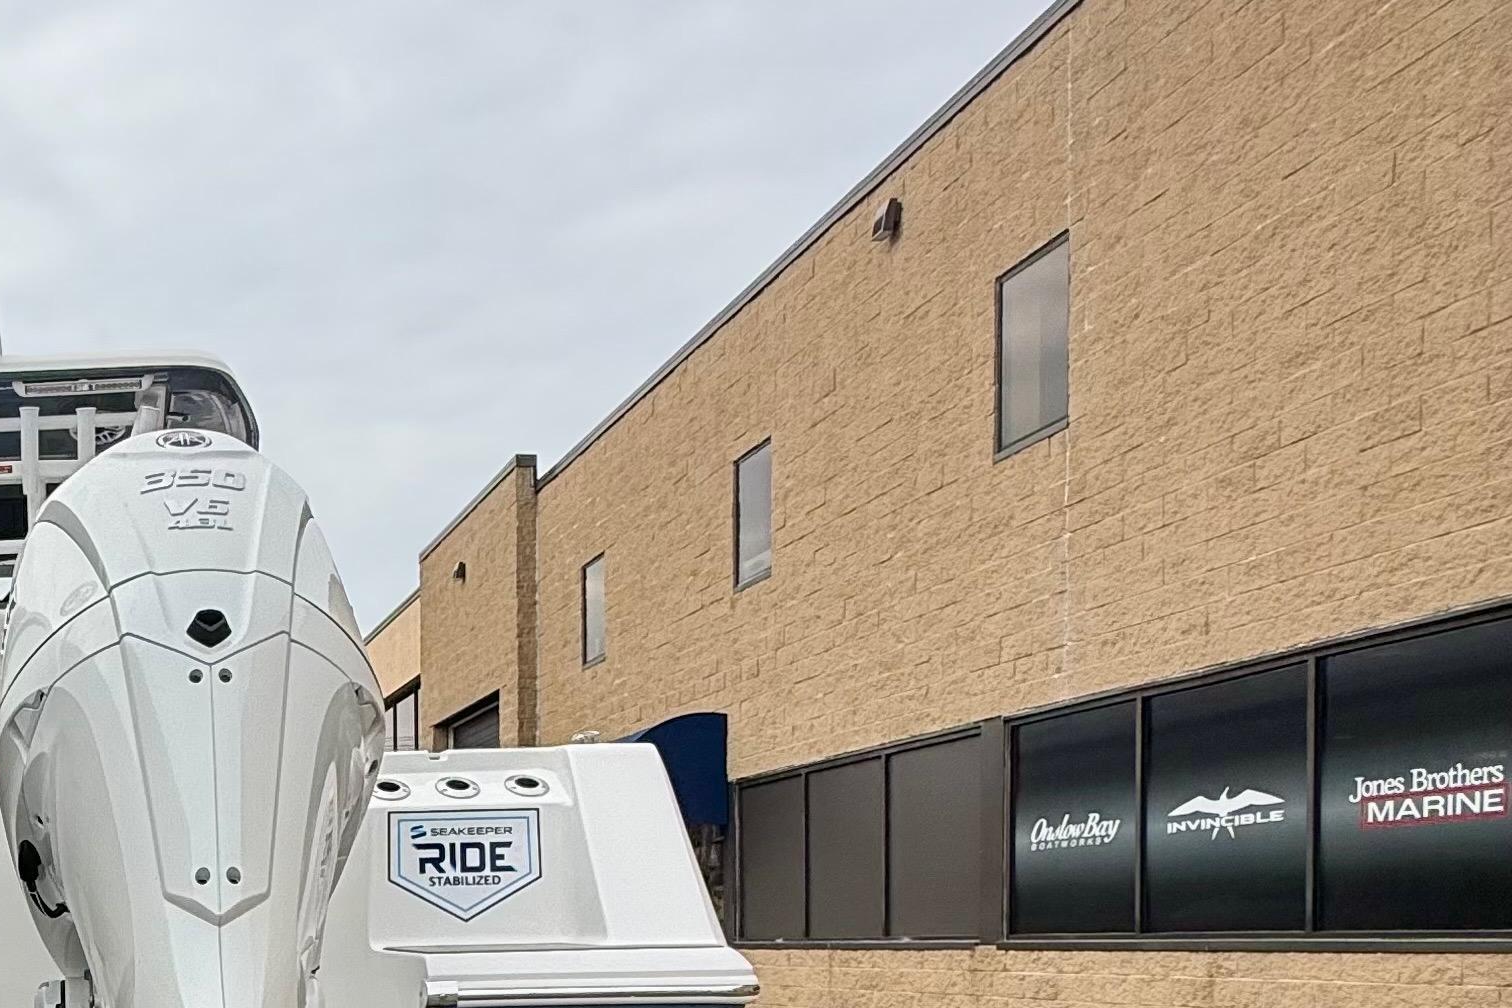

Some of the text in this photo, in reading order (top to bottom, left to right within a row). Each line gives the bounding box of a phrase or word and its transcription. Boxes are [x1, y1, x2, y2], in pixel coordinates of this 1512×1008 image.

[139, 468, 247, 492] 350
[163, 497, 230, 516] V6
[1348, 762, 1505, 803] Jones Brothers
[1366, 788, 1505, 823] MARINE
[430, 826, 513, 837] SEAKEEPER
[1167, 809, 1285, 835] INVINCIBLE
[1030, 836, 1102, 852] BOATWORKS
[412, 841, 519, 875] RIDE
[428, 874, 502, 887] STABILIZED
